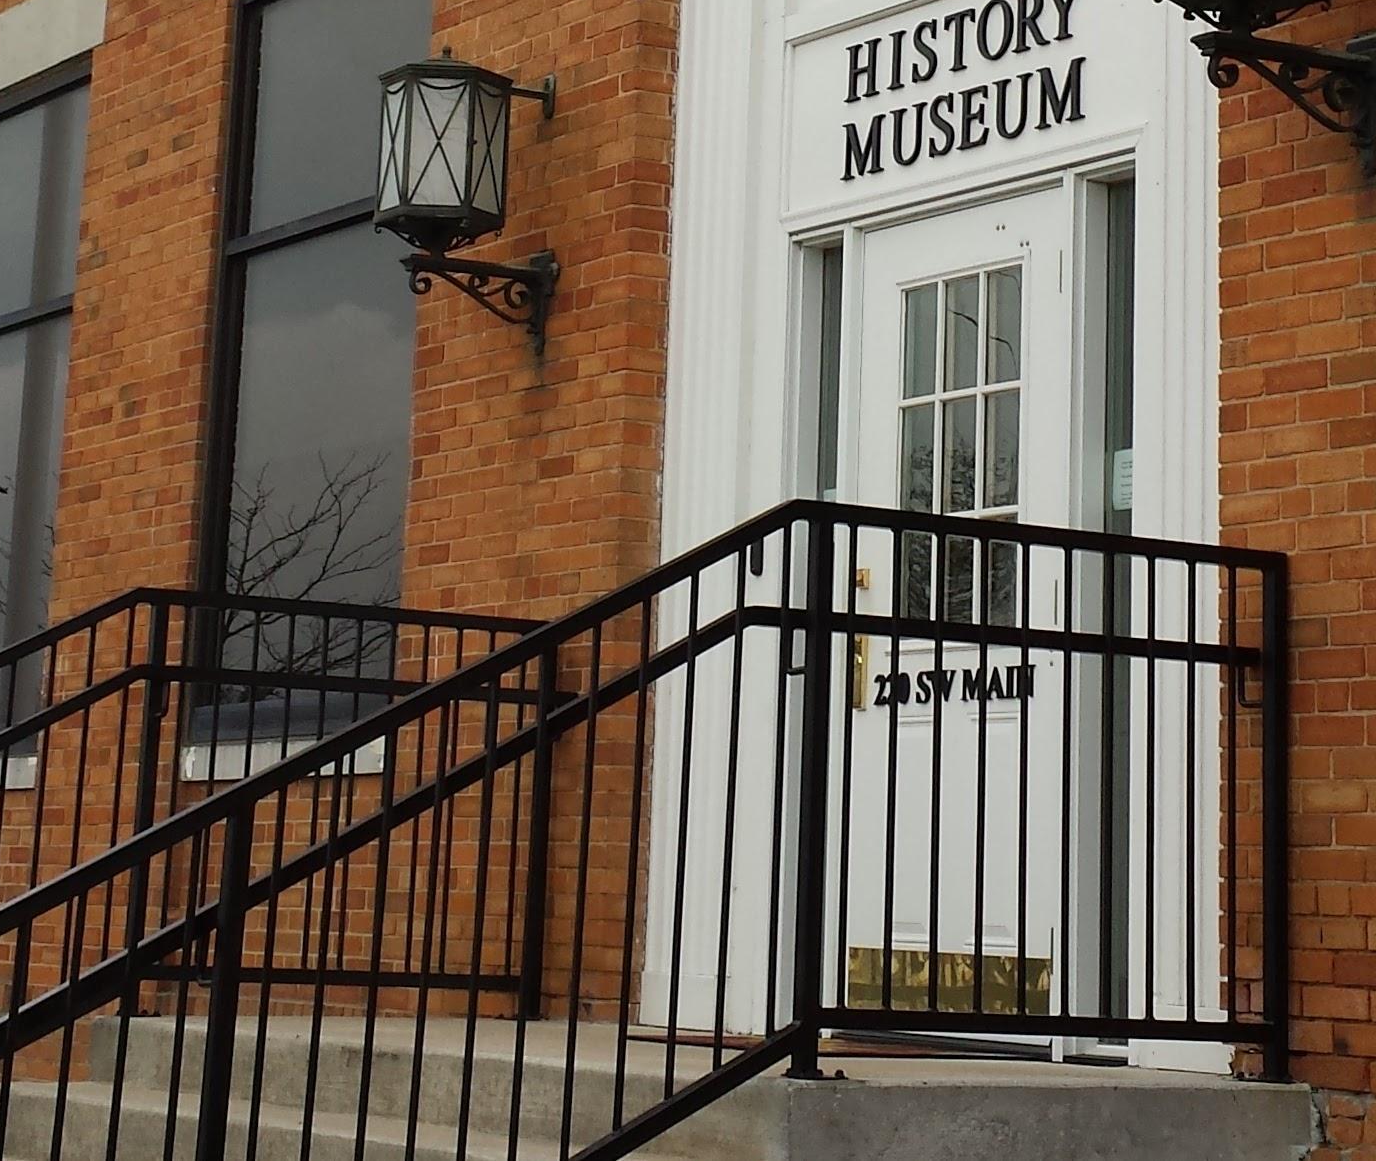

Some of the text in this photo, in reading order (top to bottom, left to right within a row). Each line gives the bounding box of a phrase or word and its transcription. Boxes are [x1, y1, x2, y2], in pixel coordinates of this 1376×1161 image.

[840, 56, 1087, 182] MUSEUM
[915, 669, 957, 704] SW
[960, 664, 1036, 702] MAIN
